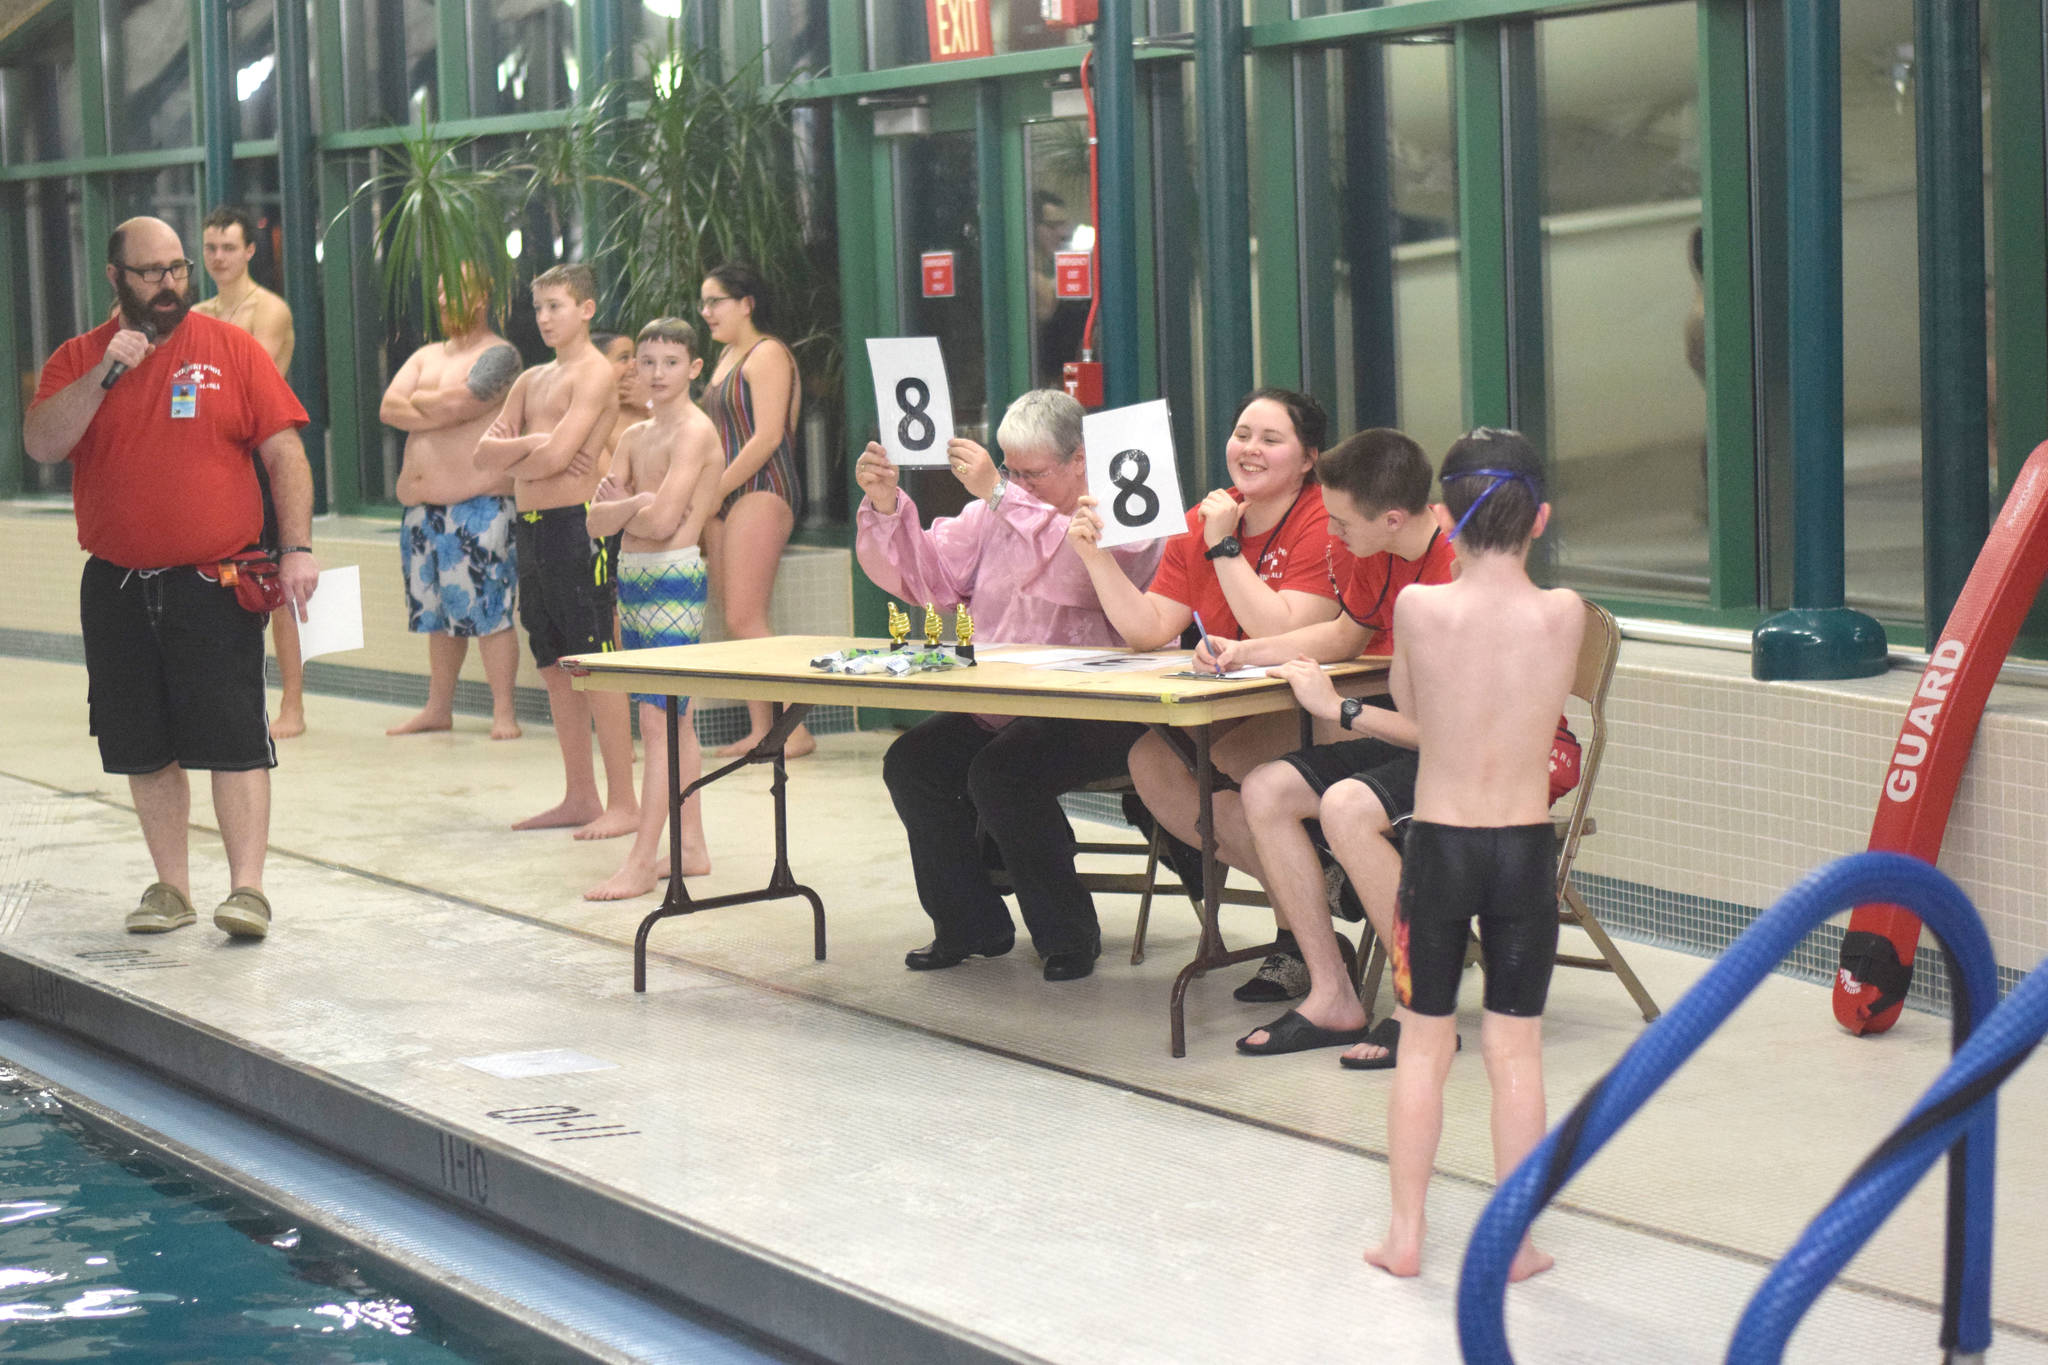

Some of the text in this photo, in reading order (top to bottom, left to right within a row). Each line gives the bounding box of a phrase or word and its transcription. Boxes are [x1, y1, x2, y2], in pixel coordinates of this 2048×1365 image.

[935, 0, 980, 55] EXIT
[895, 377, 936, 451] 8
[1108, 448, 1161, 528] 8
[1886, 639, 1965, 803] GUARD
[1550, 748, 1572, 768] ARD
[438, 1131, 488, 1203] 11-10
